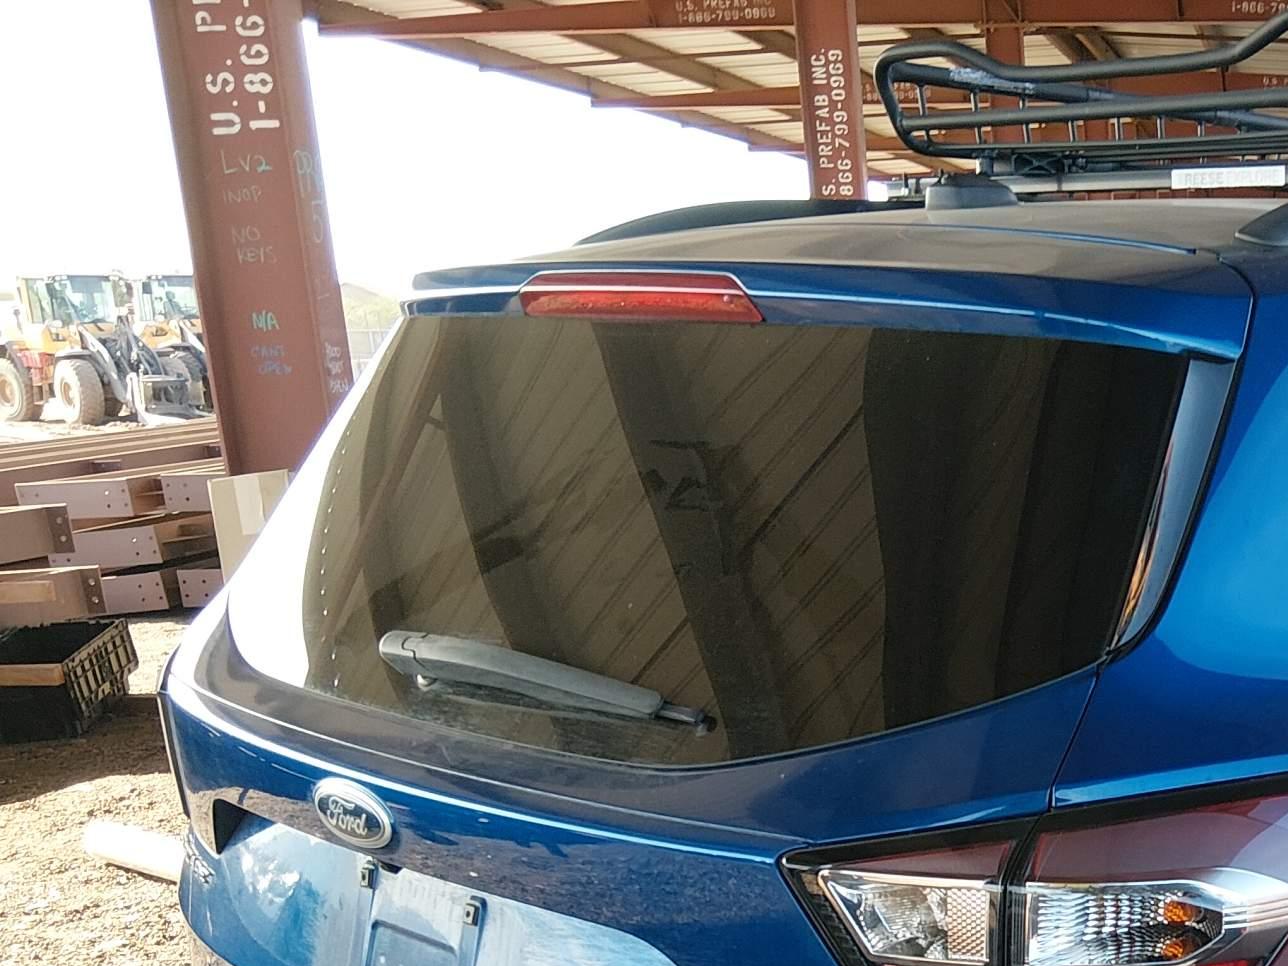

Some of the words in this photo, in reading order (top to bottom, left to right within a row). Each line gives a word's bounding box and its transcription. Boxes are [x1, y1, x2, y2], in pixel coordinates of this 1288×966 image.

[191, 0, 227, 32] P
[810, 47, 828, 86] INC.
[204, 58, 242, 136] U.S.
[814, 94, 835, 169] PREFAB
[1184, 171, 1225, 187] REESE
[251, 309, 281, 332] N/A
[326, 796, 368, 836] Ford
